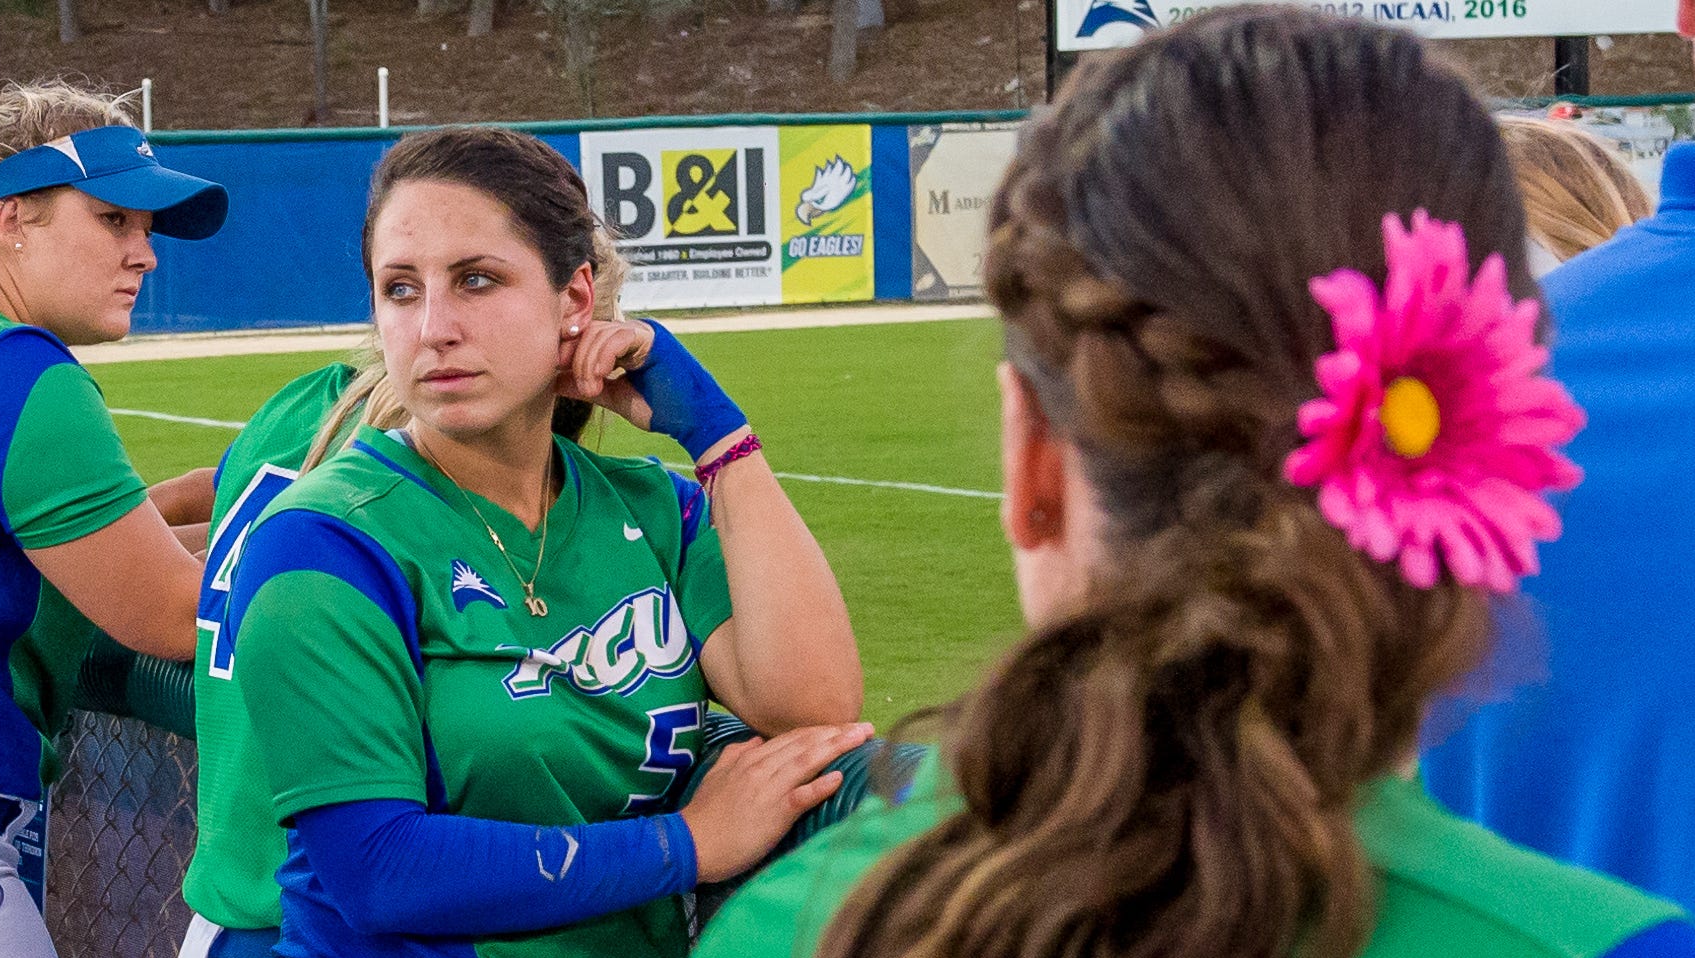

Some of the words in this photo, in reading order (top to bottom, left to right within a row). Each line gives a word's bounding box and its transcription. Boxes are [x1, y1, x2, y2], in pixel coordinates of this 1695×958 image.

[1465, 0, 1527, 18] 2016
[602, 148, 766, 240] B&I
[789, 236, 807, 258] GO
[808, 234, 864, 256] EAGLES!
[525, 597, 549, 617] 10
